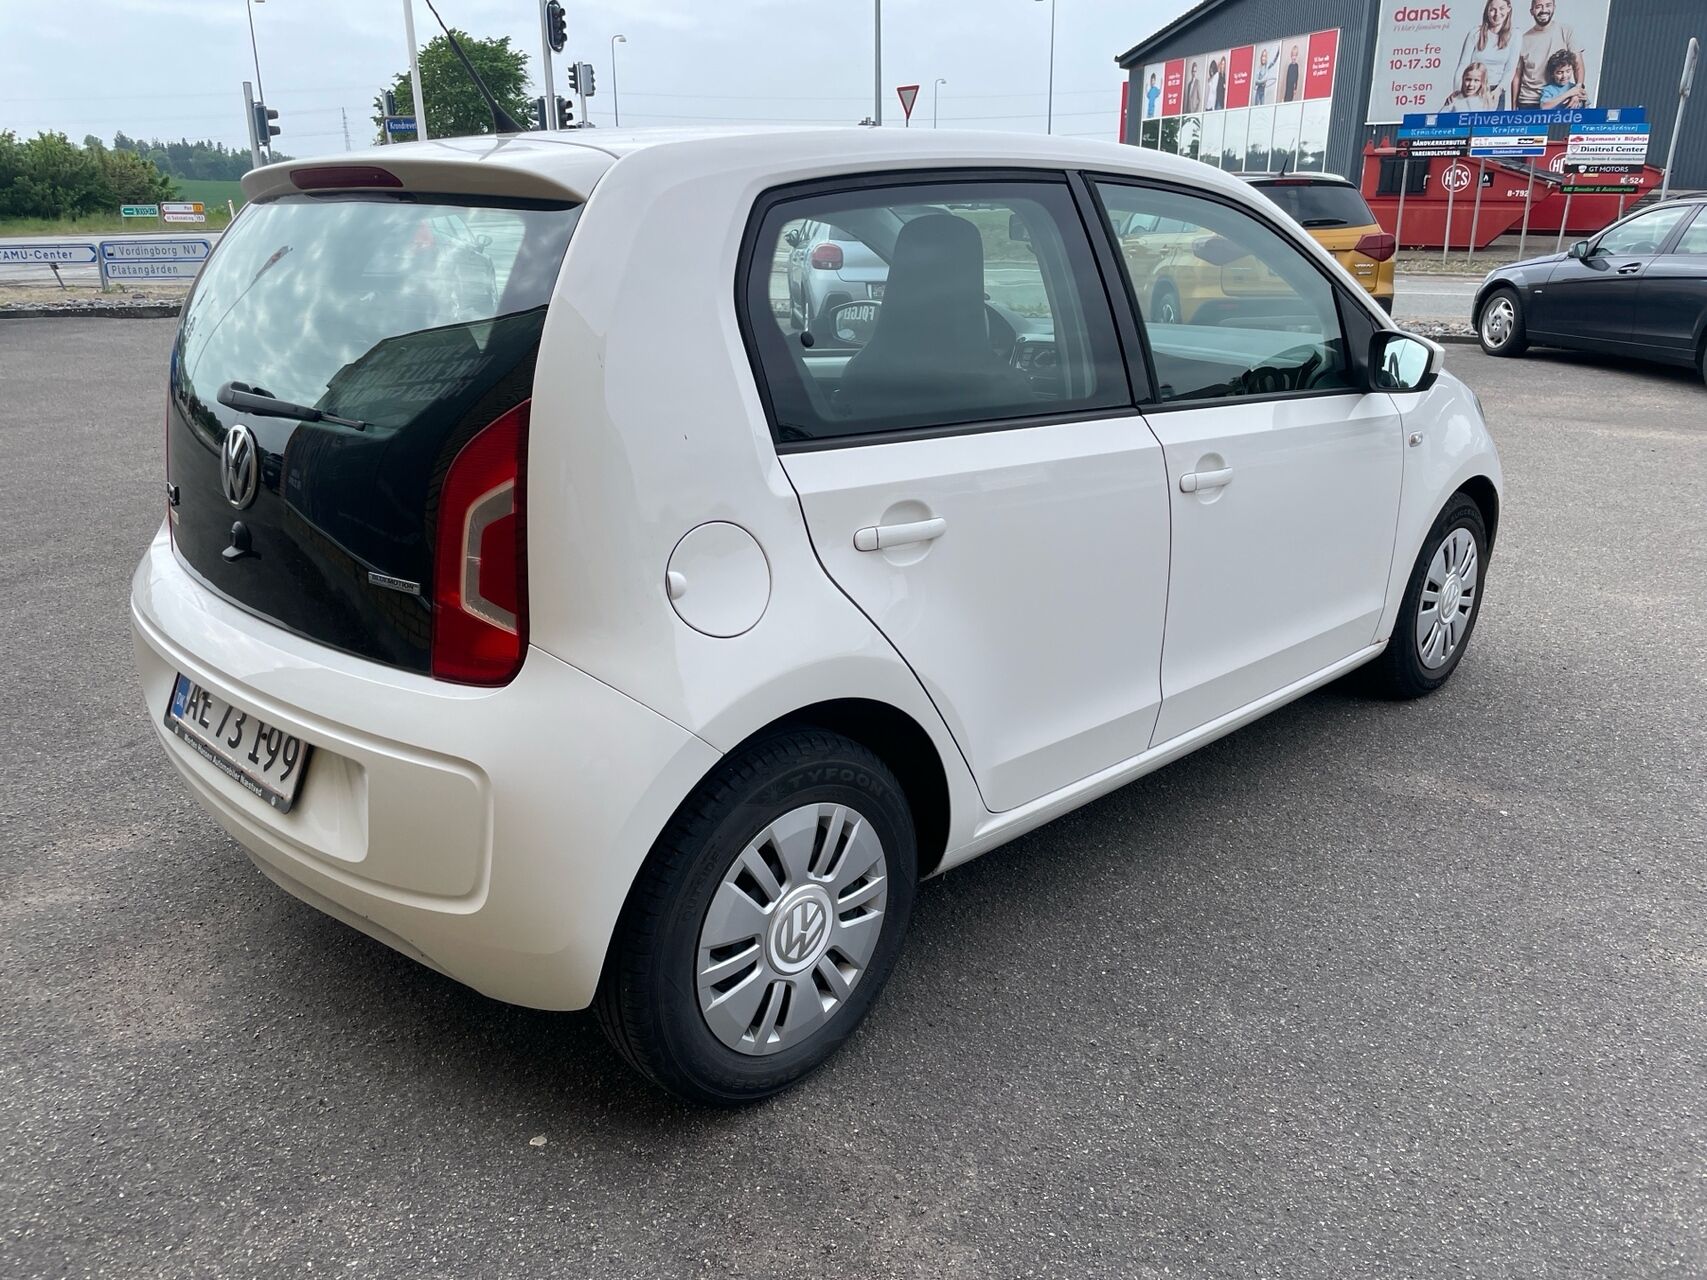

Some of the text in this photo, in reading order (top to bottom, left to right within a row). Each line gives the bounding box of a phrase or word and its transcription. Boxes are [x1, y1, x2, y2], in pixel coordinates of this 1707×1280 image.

[1394, 4, 1451, 22] dansk
[1392, 43, 1441, 55] man-fre
[1390, 58, 1441, 70] 10-17.30
[1391, 81, 1433, 92] lør-søn
[1395, 95, 1426, 105] 10-15
[1458, 110, 1583, 126] Erhvervsområde
[1580, 145, 1645, 153] Dinitrol Center
[1552, 157, 1566, 174] HC
[1444, 169, 1468, 188] HCS
[118, 245, 197, 257] Vordingborg NV
[111, 264, 178, 277] Platangården
[185, 684, 213, 730] AE
[247, 719, 301, 782] 199
[787, 767, 884, 797] TYFOON
